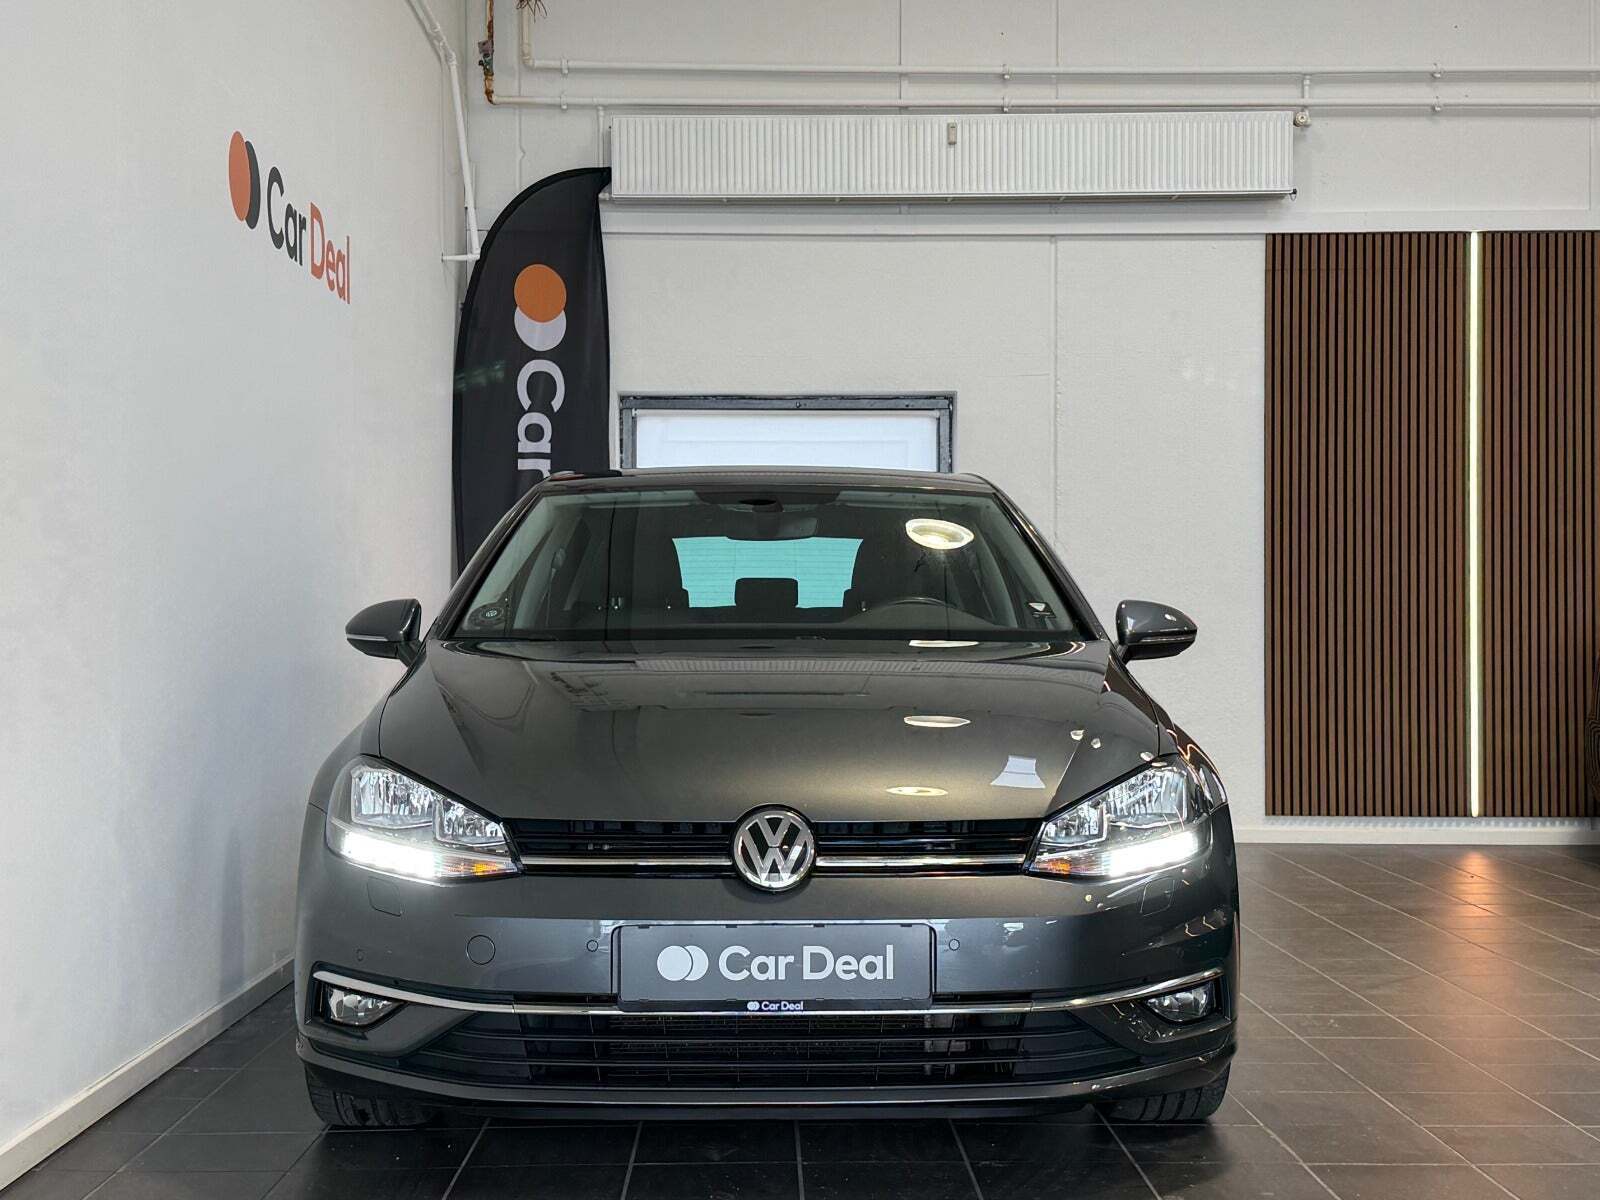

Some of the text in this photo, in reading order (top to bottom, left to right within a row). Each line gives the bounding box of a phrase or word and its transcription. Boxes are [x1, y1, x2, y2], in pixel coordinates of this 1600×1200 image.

[267, 166, 350, 305] Car Deal
[516, 359, 566, 479] Car
[718, 944, 895, 981] Car Deal
[761, 1000, 804, 1011] Car Deal
